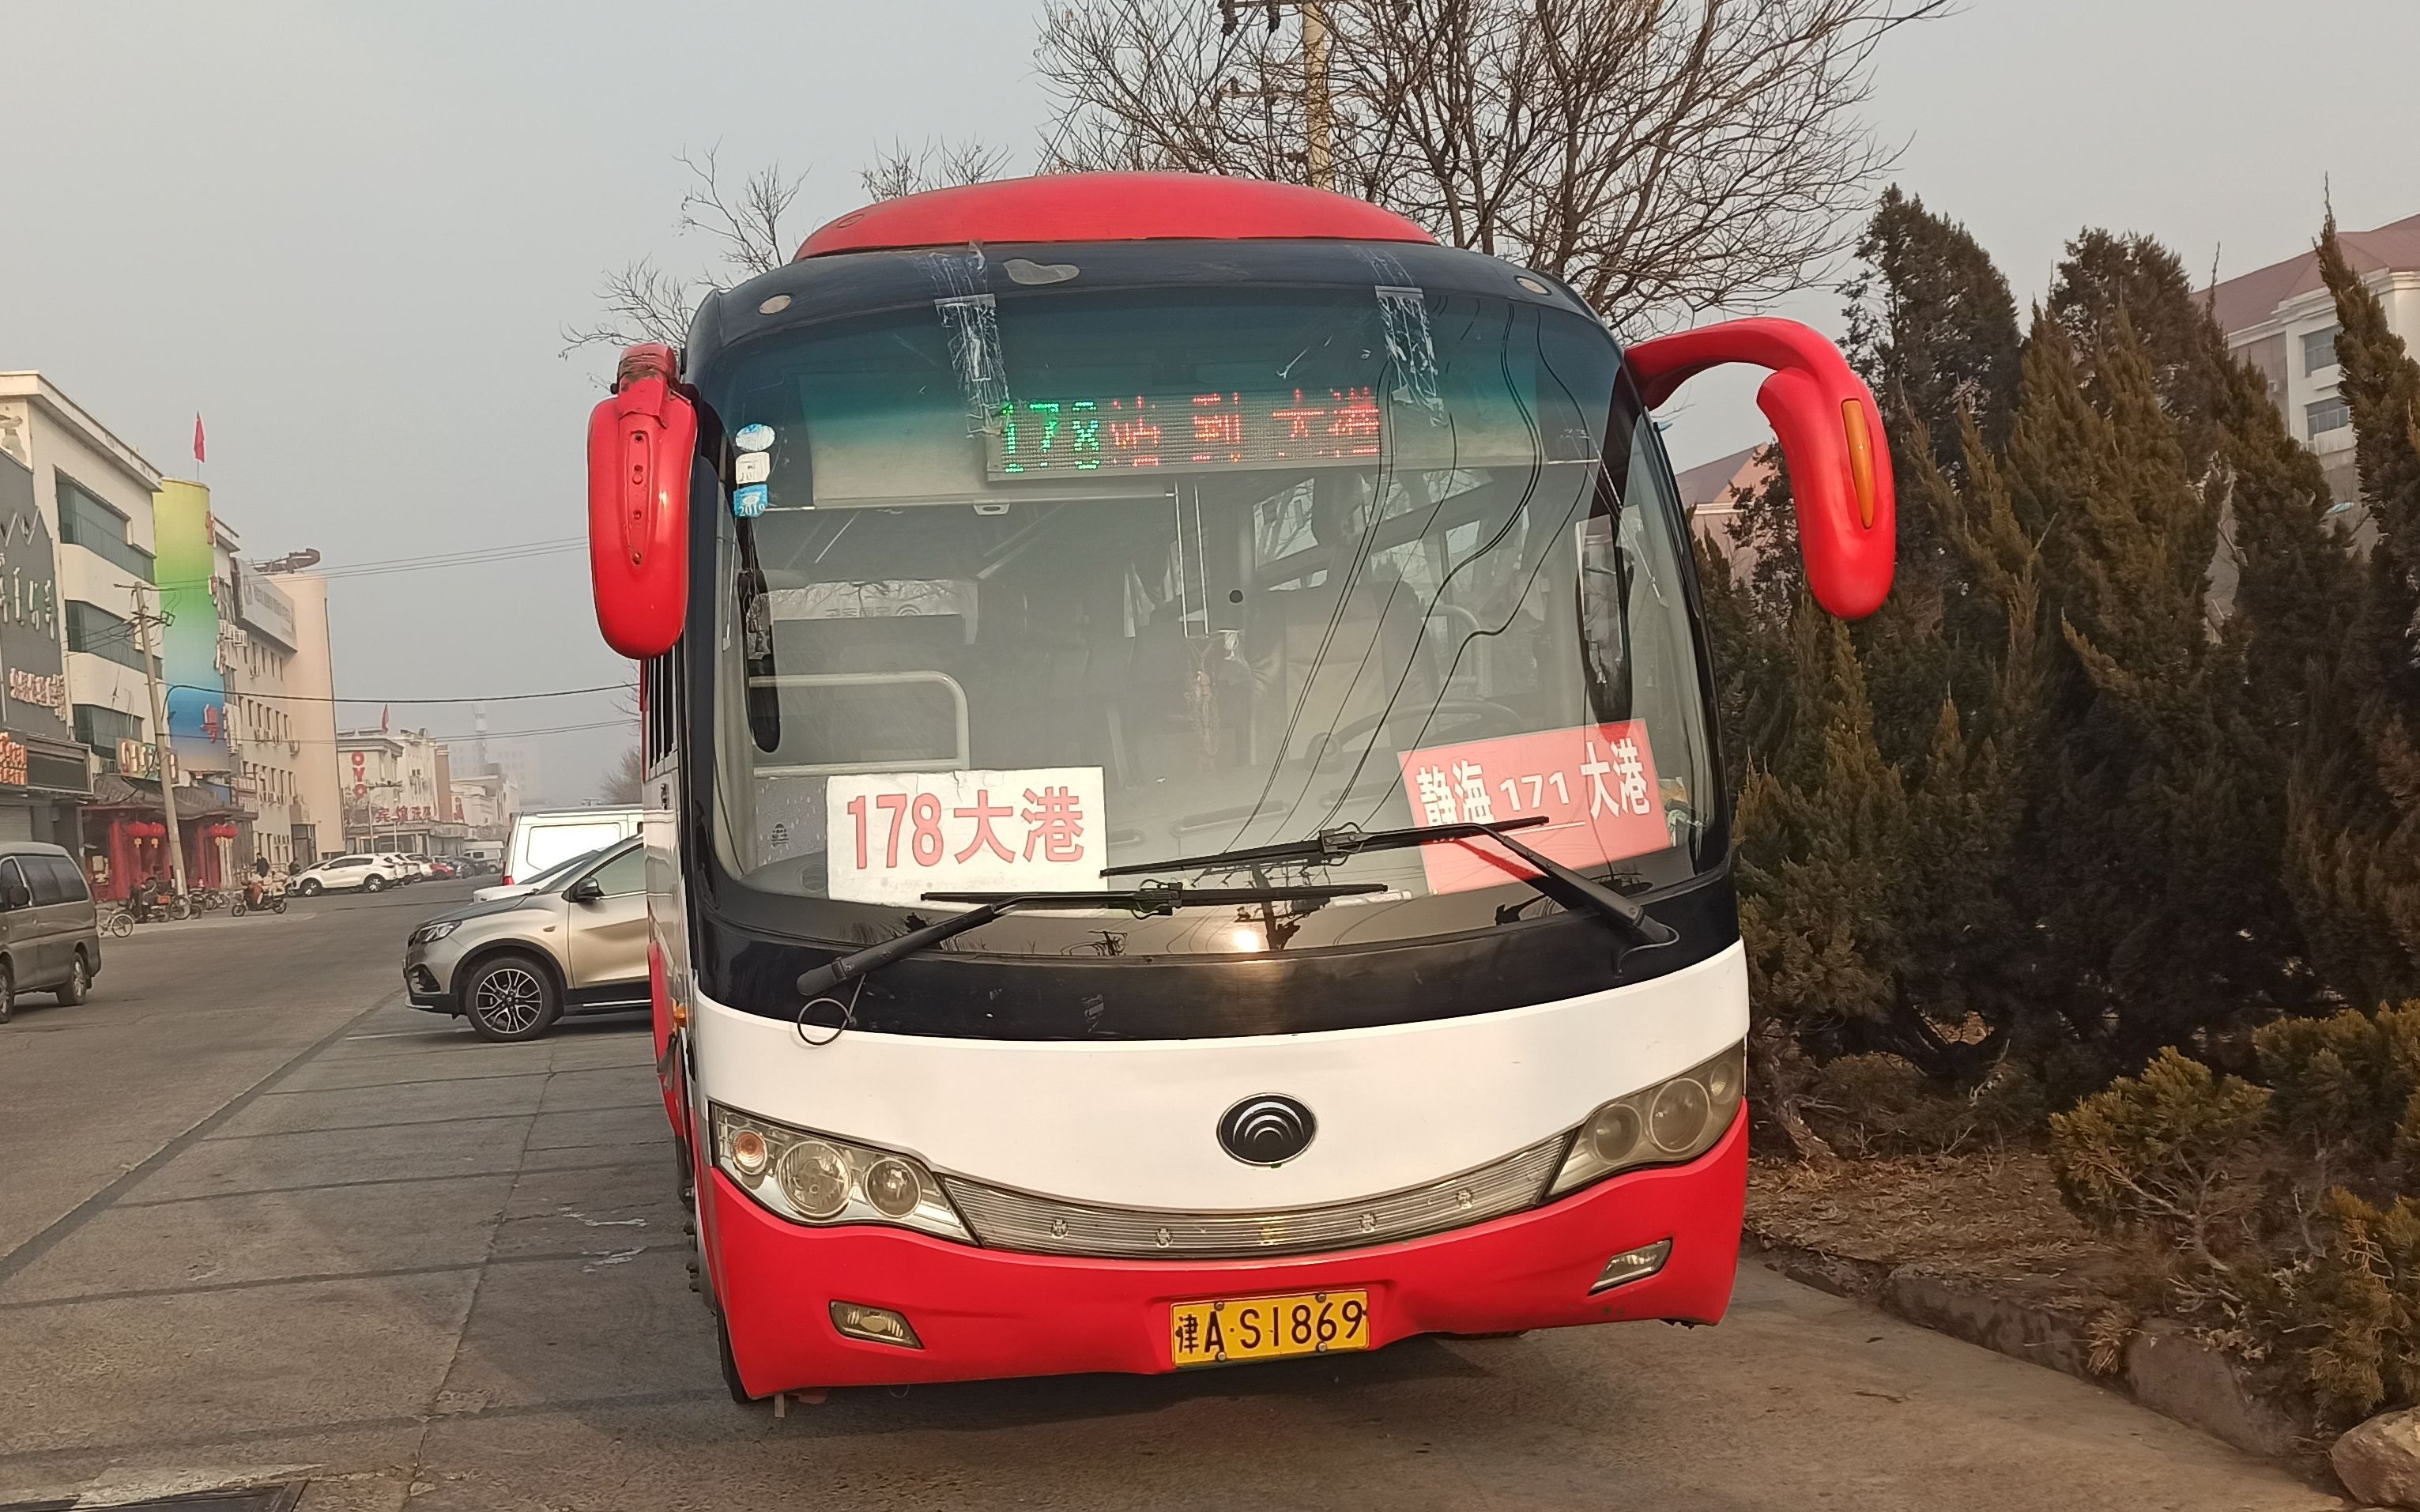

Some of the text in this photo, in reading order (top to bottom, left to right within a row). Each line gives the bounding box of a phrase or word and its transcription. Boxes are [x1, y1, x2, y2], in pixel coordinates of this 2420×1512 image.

[999, 400, 1100, 473] 178
[738, 503, 766, 518] 2019
[351, 752, 368, 798] OYO
[1499, 771, 1570, 813] 171
[1580, 737, 1652, 821] 大港
[847, 786, 1084, 870] 178大港
